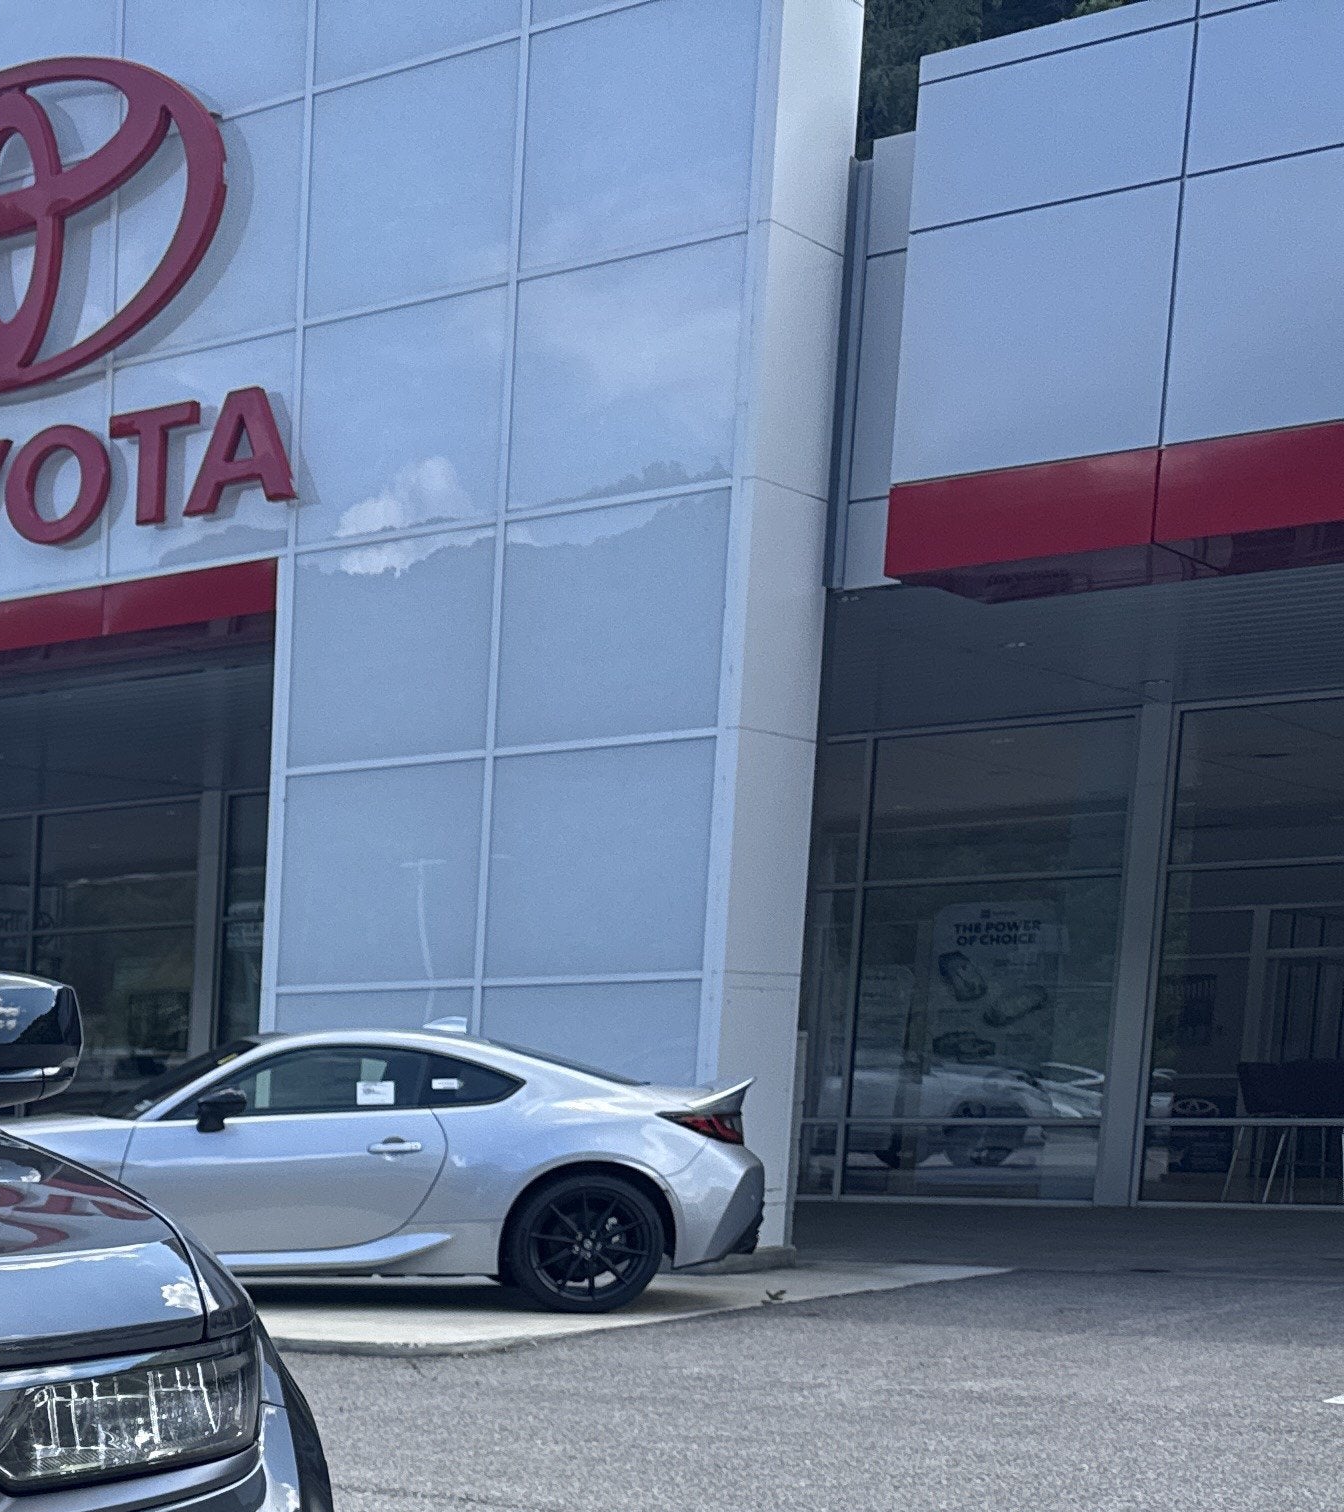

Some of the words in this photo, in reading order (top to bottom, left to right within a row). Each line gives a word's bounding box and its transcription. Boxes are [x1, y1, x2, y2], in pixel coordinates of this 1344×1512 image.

[953, 922, 982, 934] THE
[985, 920, 1042, 933] POWER
[956, 935, 978, 947] OF
[979, 933, 1036, 946] CHOICE
